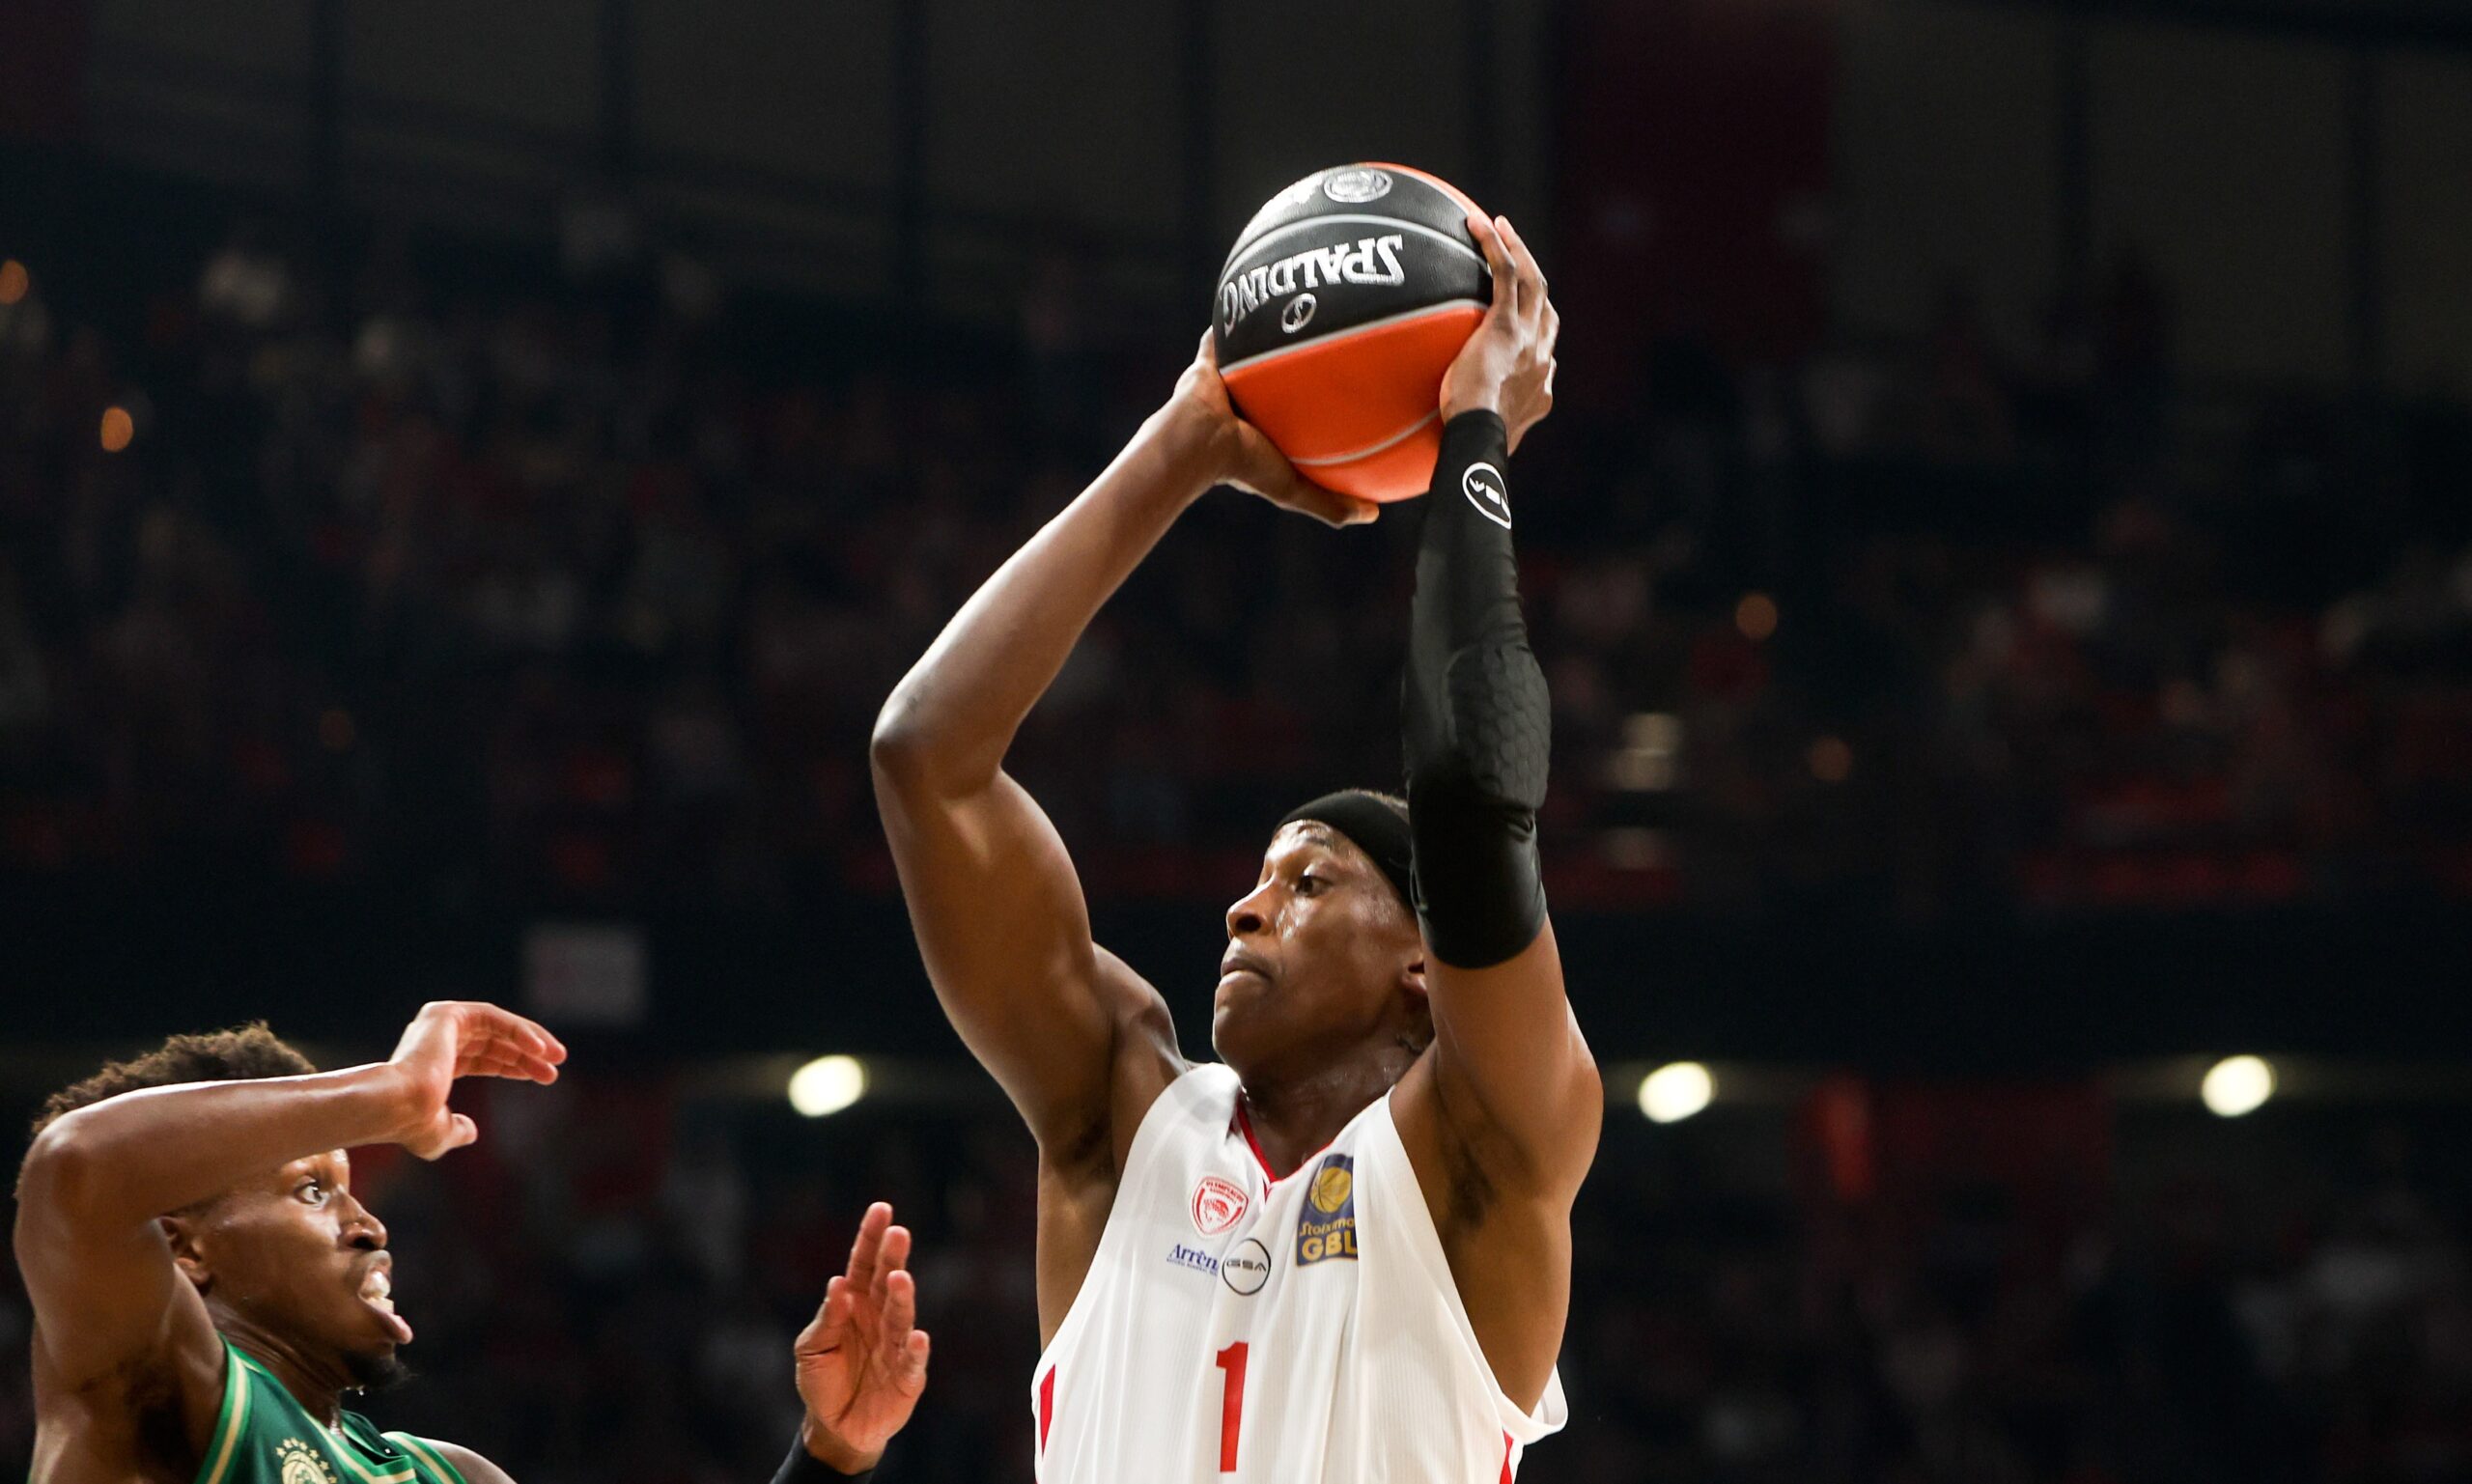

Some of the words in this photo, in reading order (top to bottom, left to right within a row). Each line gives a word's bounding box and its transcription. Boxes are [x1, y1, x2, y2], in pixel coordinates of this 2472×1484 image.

[1222, 235, 1405, 337] SPALDING
[1299, 1217, 1355, 1237] Stoixima
[1302, 1229, 1358, 1262] GBL
[1215, 1340, 1250, 1473] 1
